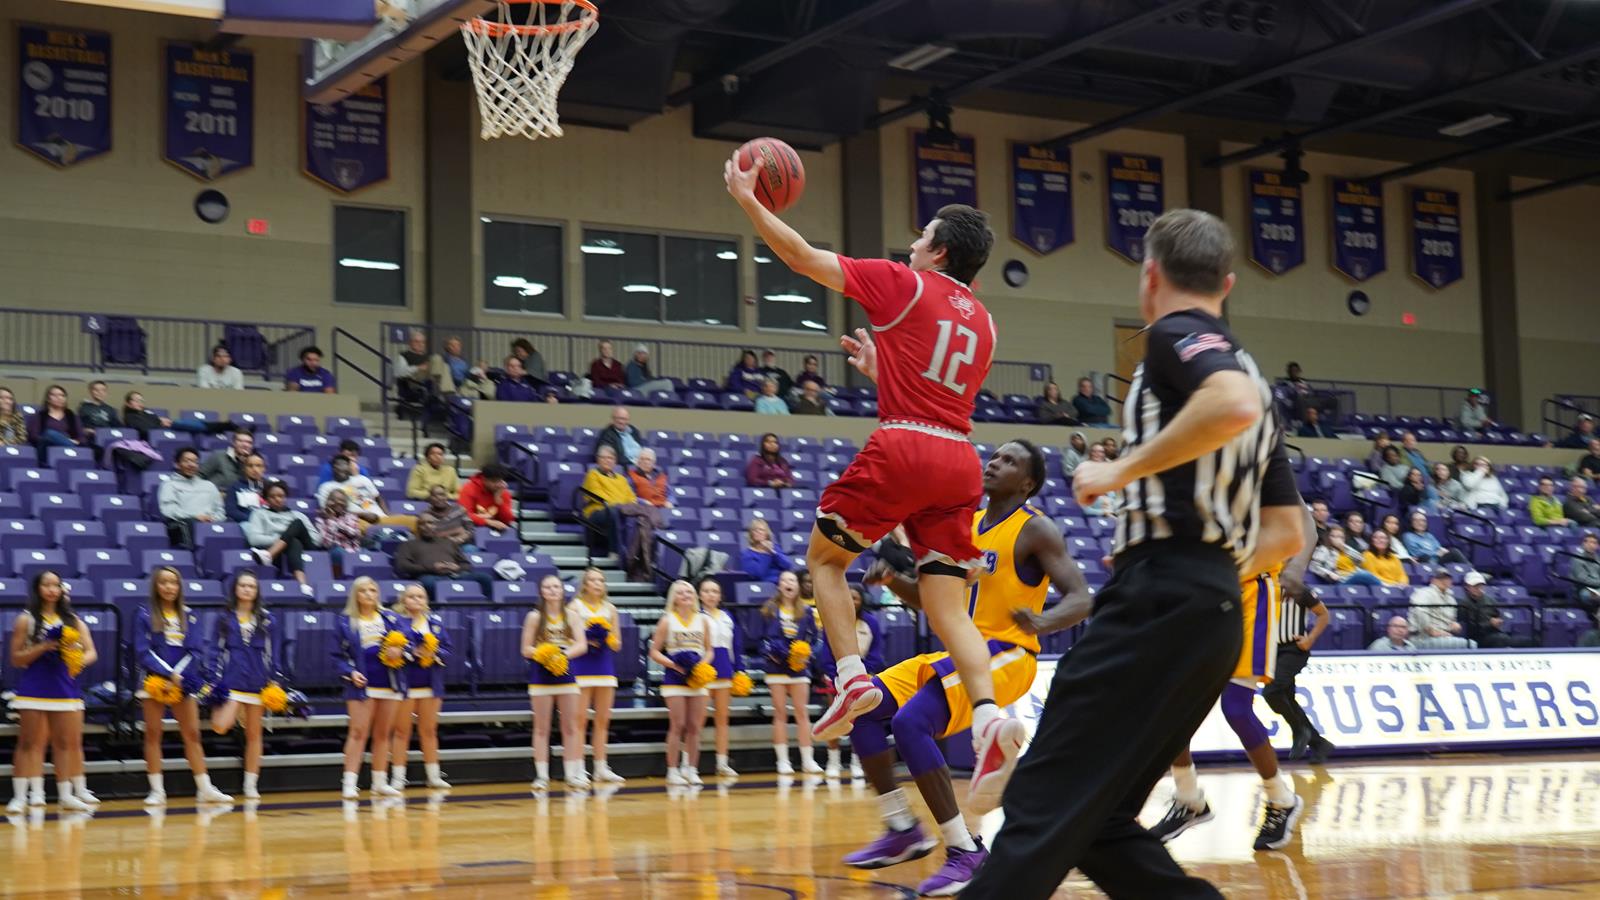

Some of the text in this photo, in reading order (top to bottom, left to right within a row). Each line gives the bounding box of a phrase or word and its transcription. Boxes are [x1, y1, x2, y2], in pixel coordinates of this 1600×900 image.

[34, 94, 95, 122] 2010
[184, 111, 237, 136] 2011
[921, 320, 978, 395] 12
